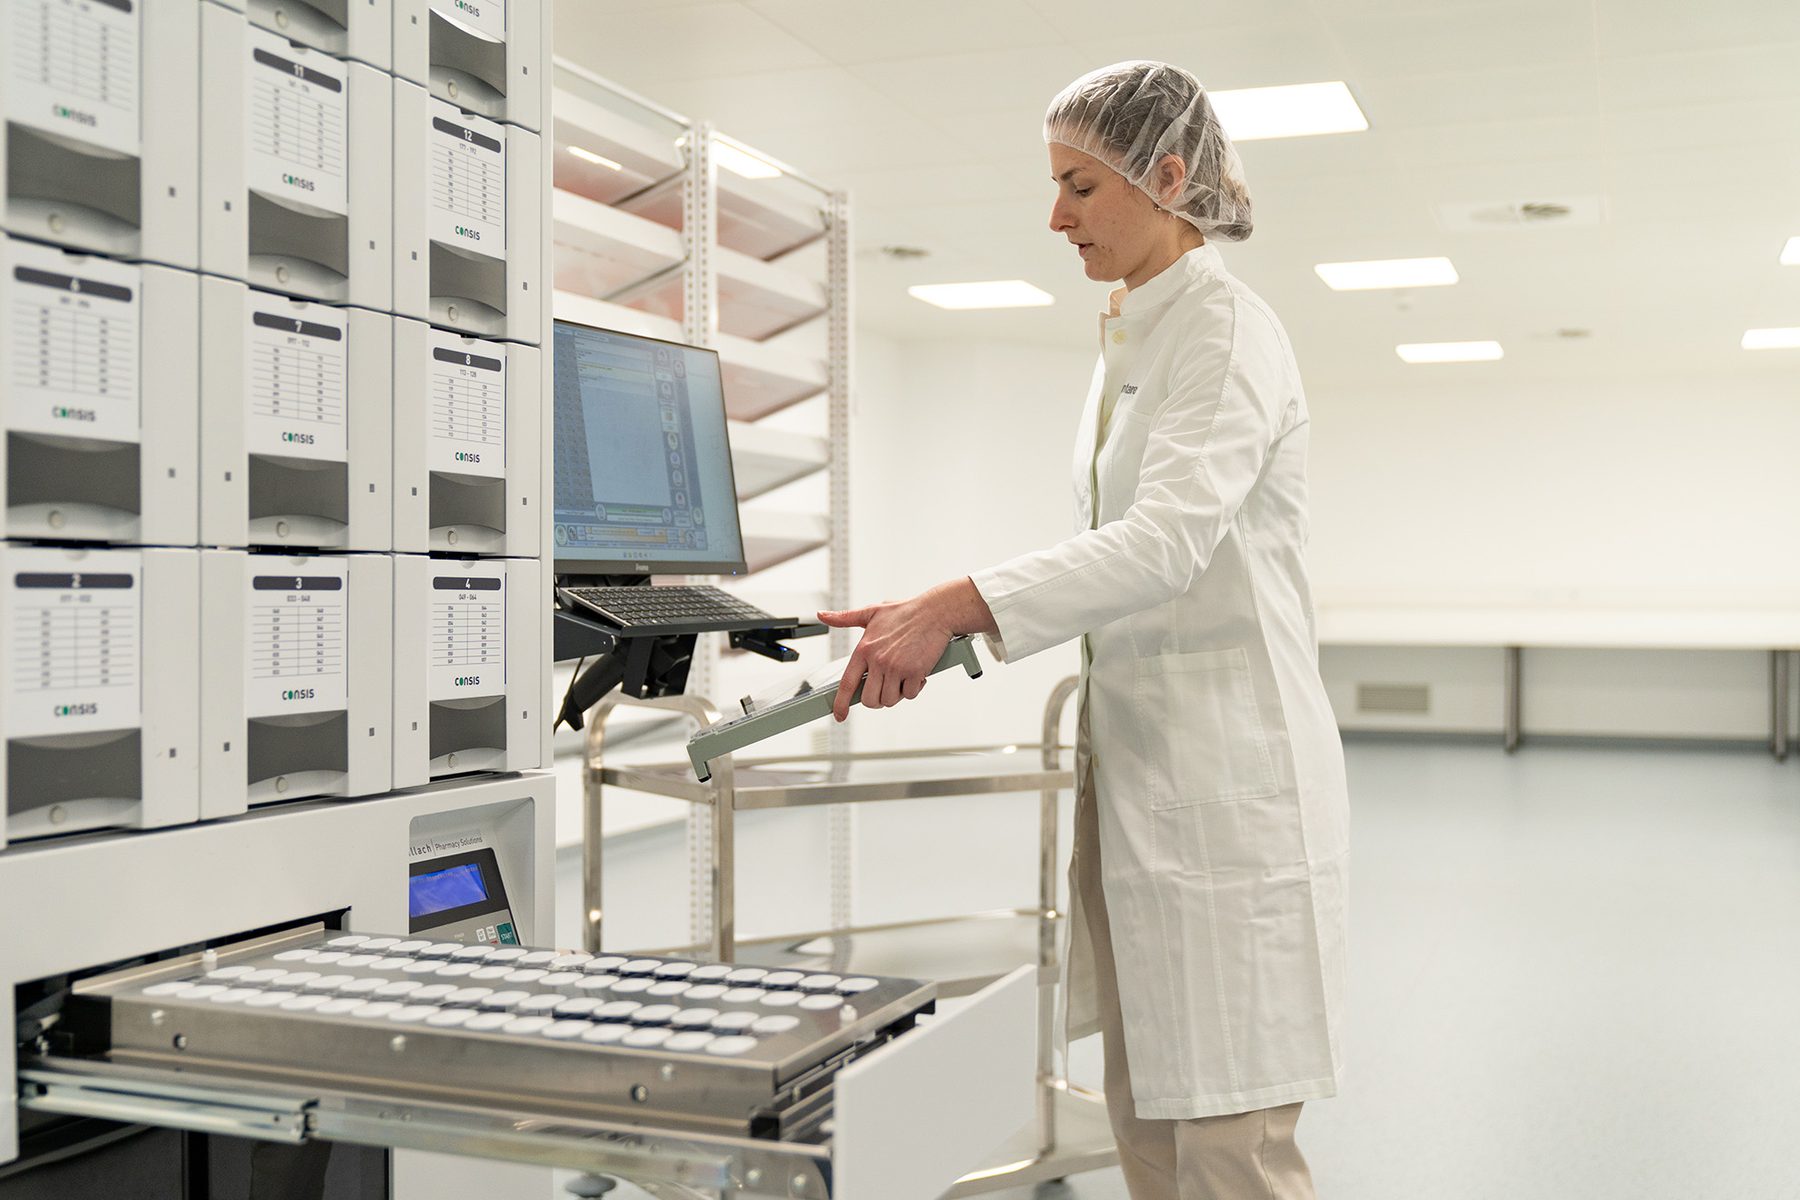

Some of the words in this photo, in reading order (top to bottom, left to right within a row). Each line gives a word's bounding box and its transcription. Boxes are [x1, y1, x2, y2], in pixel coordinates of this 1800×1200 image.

[293, 64, 304, 79] 11
[463, 129, 473, 141] 12
[295, 320, 302, 333] 7
[466, 354, 471, 365] 8
[71, 574, 81, 588] 2
[295, 577, 302, 589] 3
[465, 578, 471, 589] 4
[409, 844, 432, 857] llach
[435, 841, 460, 851] Pharmacy
[460, 836, 483, 847] Solutions
